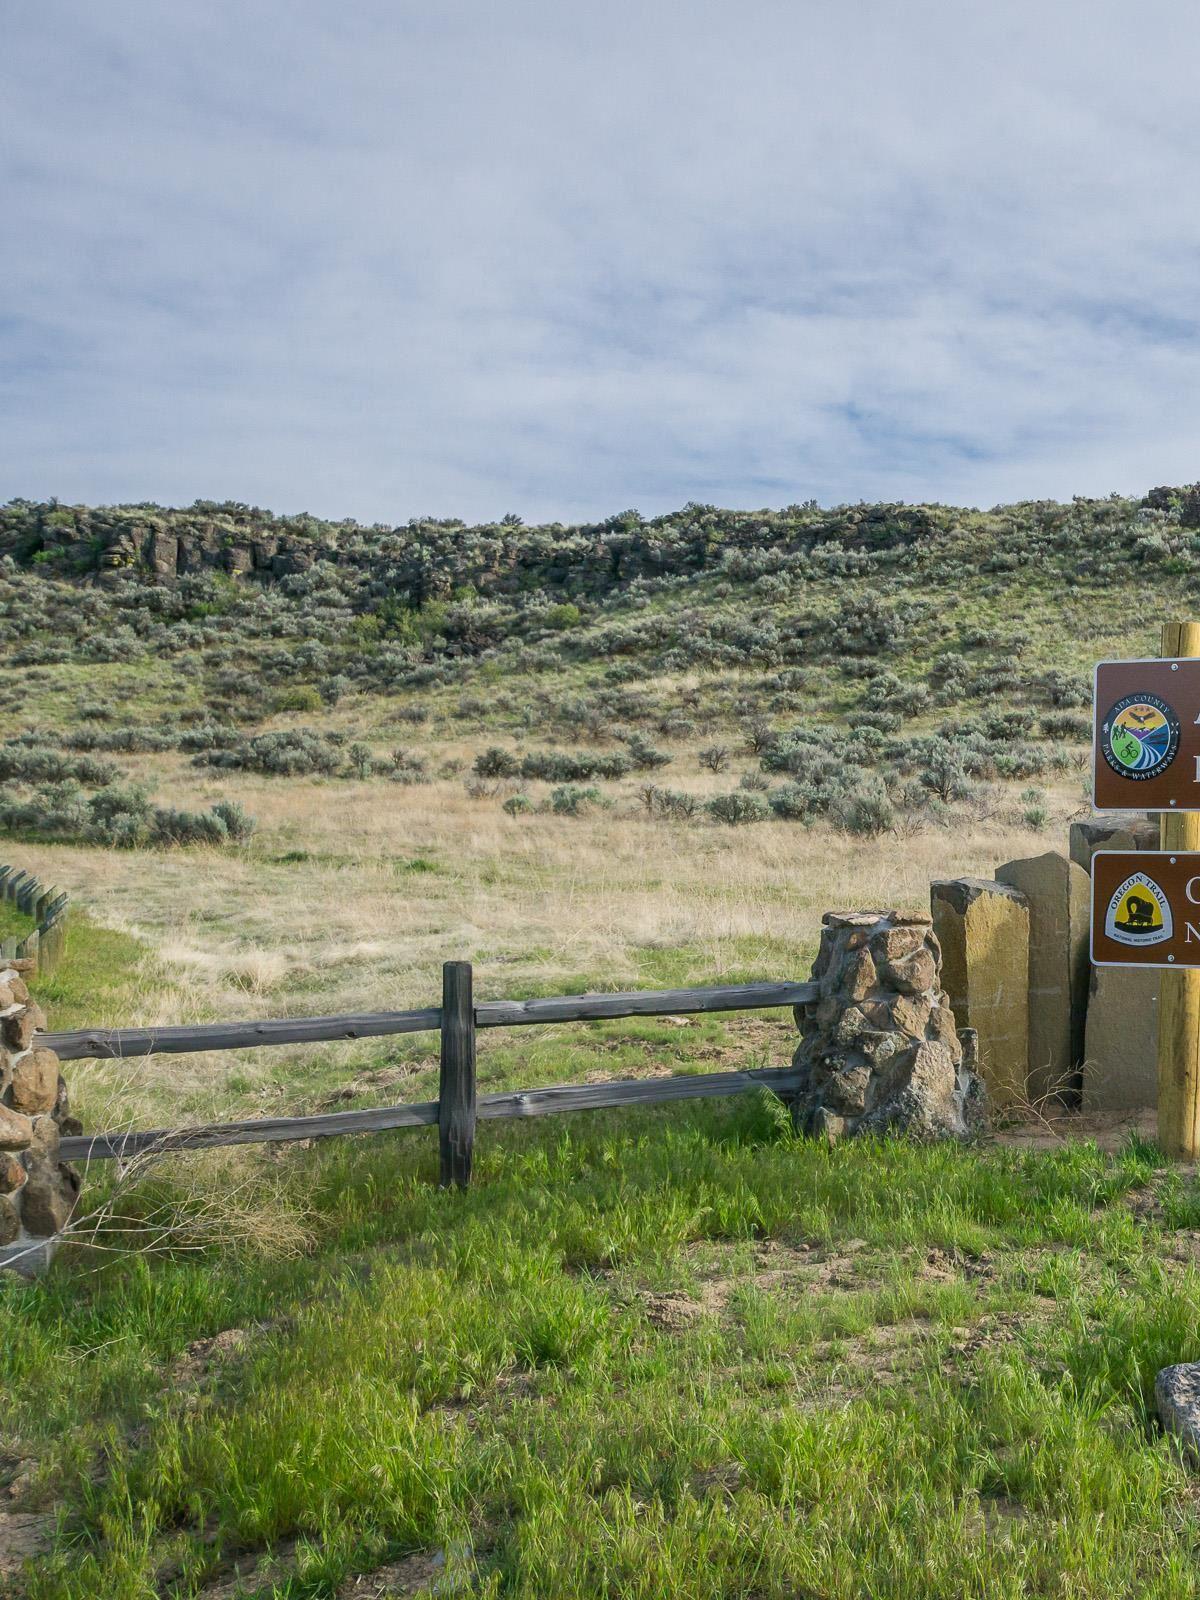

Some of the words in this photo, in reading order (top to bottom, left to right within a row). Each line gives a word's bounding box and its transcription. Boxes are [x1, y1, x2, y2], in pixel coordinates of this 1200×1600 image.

[1113, 698, 1131, 713] ADA
[1134, 695, 1170, 713] COUNTY
[1132, 745, 1177, 779] WATERWAYS
[1111, 875, 1143, 910] OREGON
[1146, 879, 1166, 908] TRAIL
